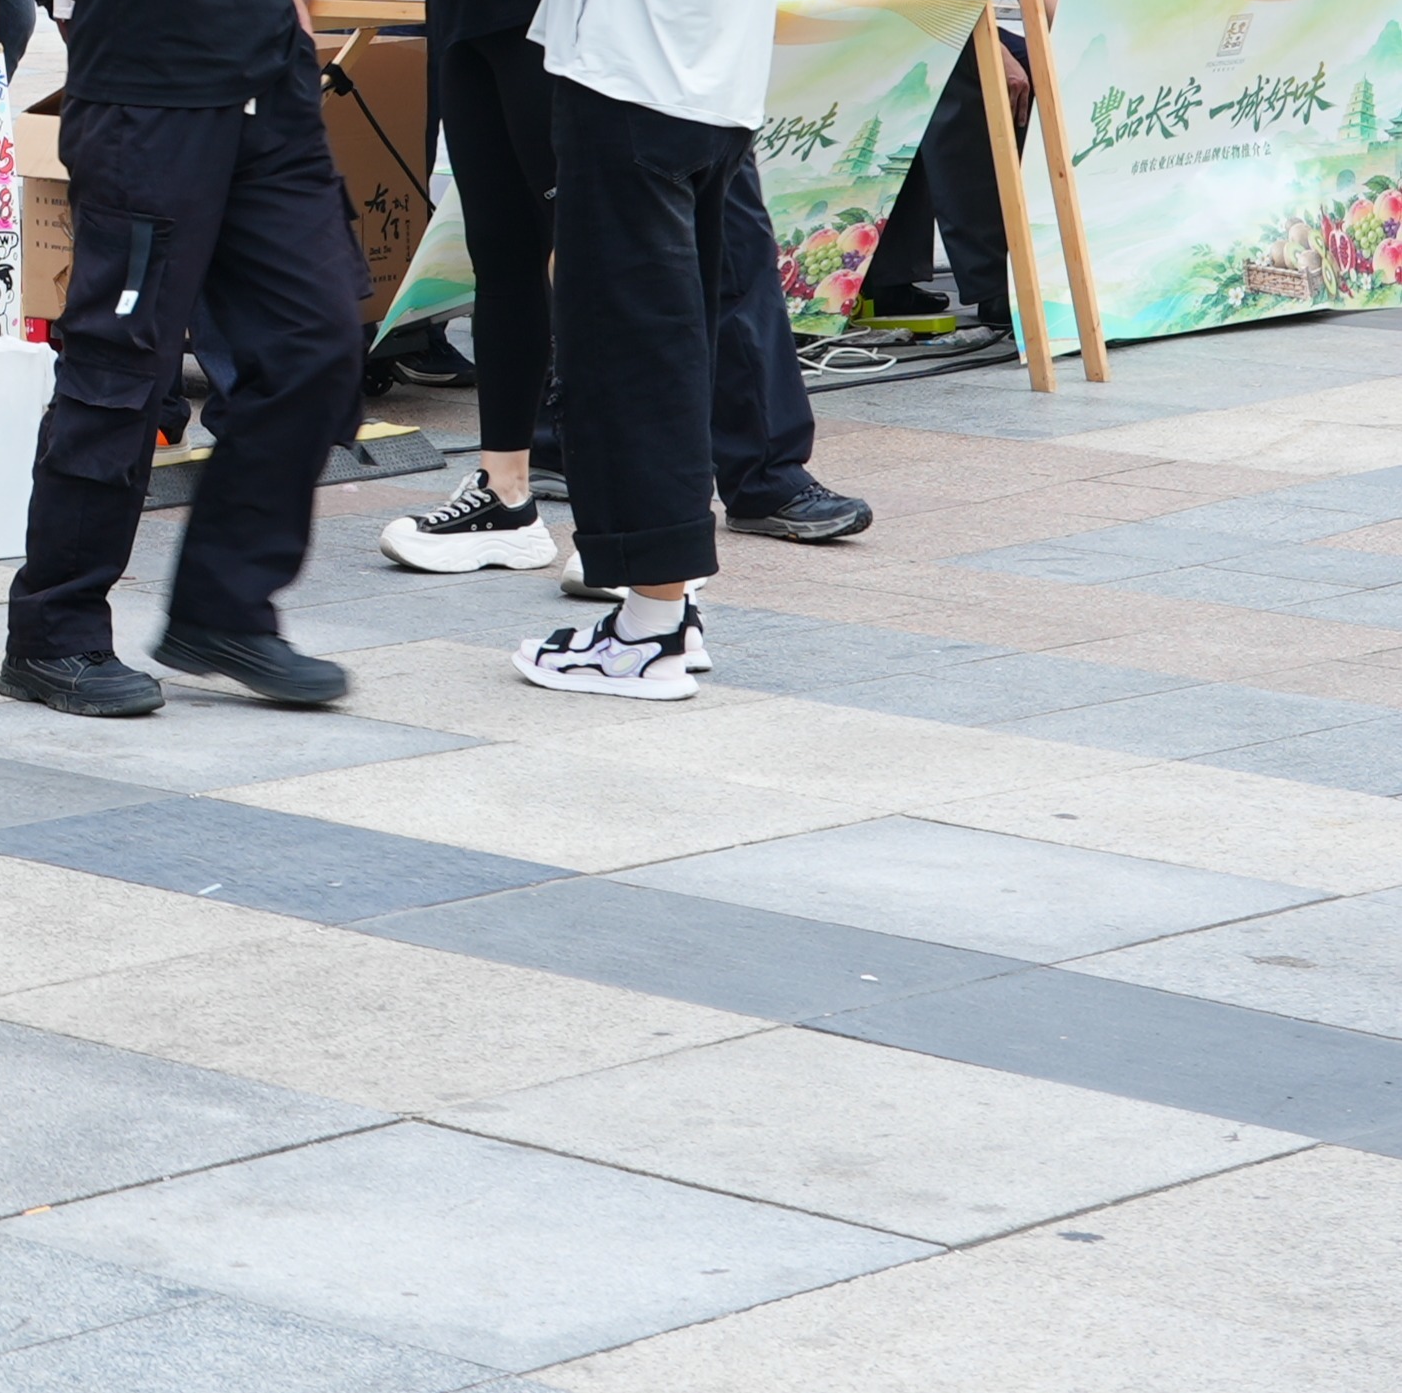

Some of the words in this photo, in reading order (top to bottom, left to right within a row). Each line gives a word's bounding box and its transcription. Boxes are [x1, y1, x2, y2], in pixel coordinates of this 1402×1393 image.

[1209, 61, 1339, 132] 一城好味
[753, 102, 842, 166] 好味
[1130, 141, 1272, 176] 市级农业区域公共品牌好物推介会
